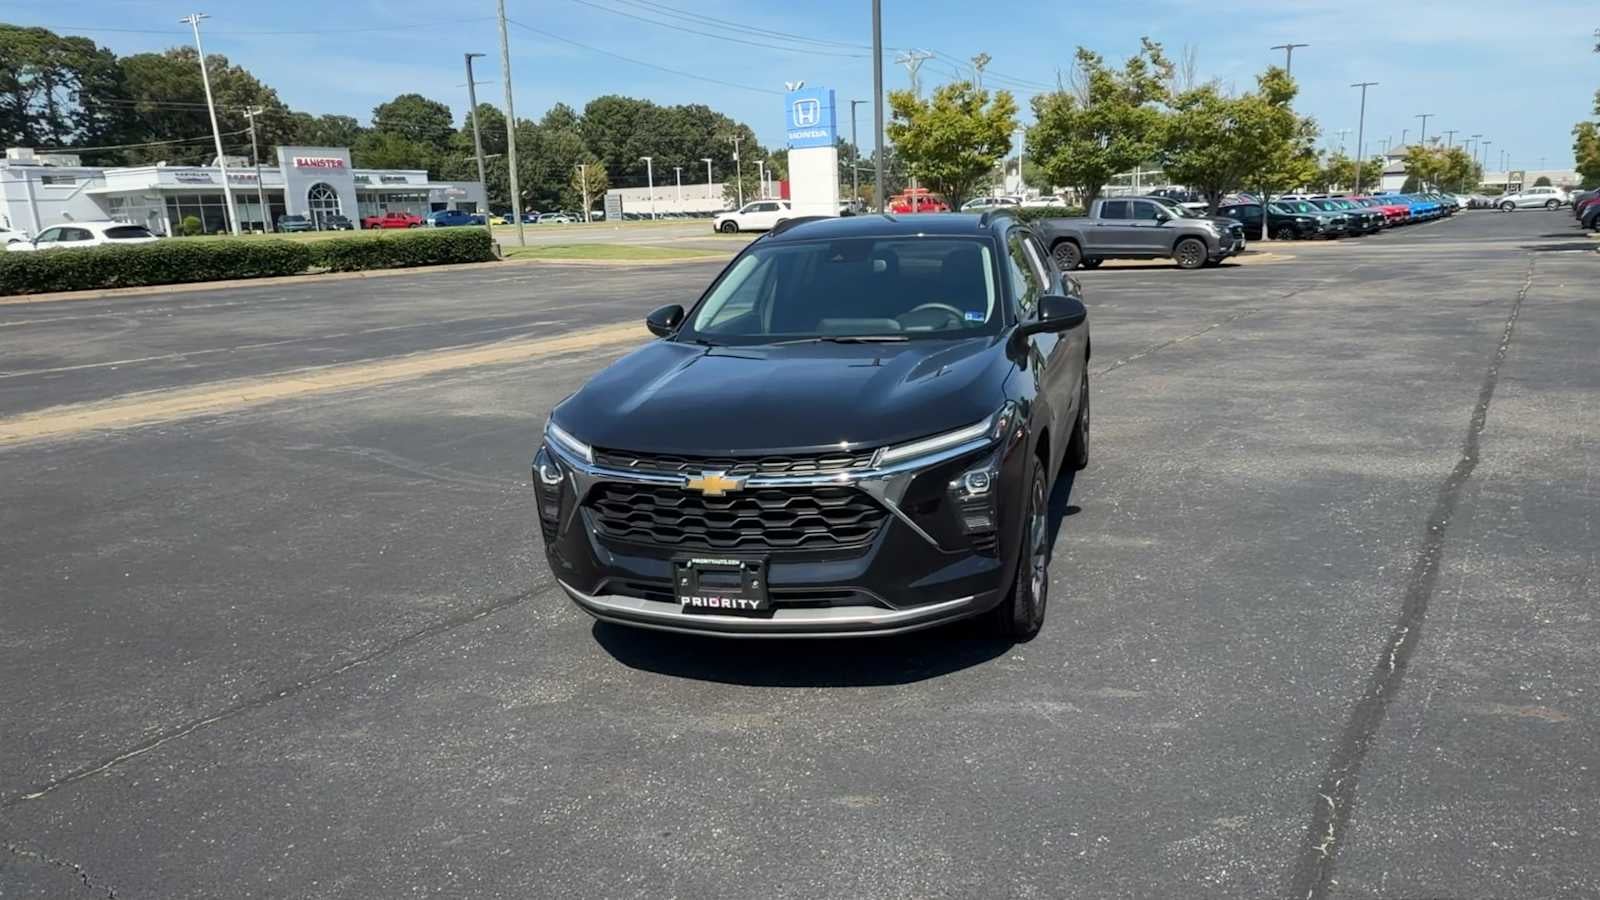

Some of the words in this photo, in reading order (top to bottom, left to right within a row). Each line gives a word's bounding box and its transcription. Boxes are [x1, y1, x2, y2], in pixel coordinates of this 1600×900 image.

[788, 130, 828, 140] HONDA
[293, 157, 344, 169] BANISTER
[680, 596, 760, 610] PRIORITY
